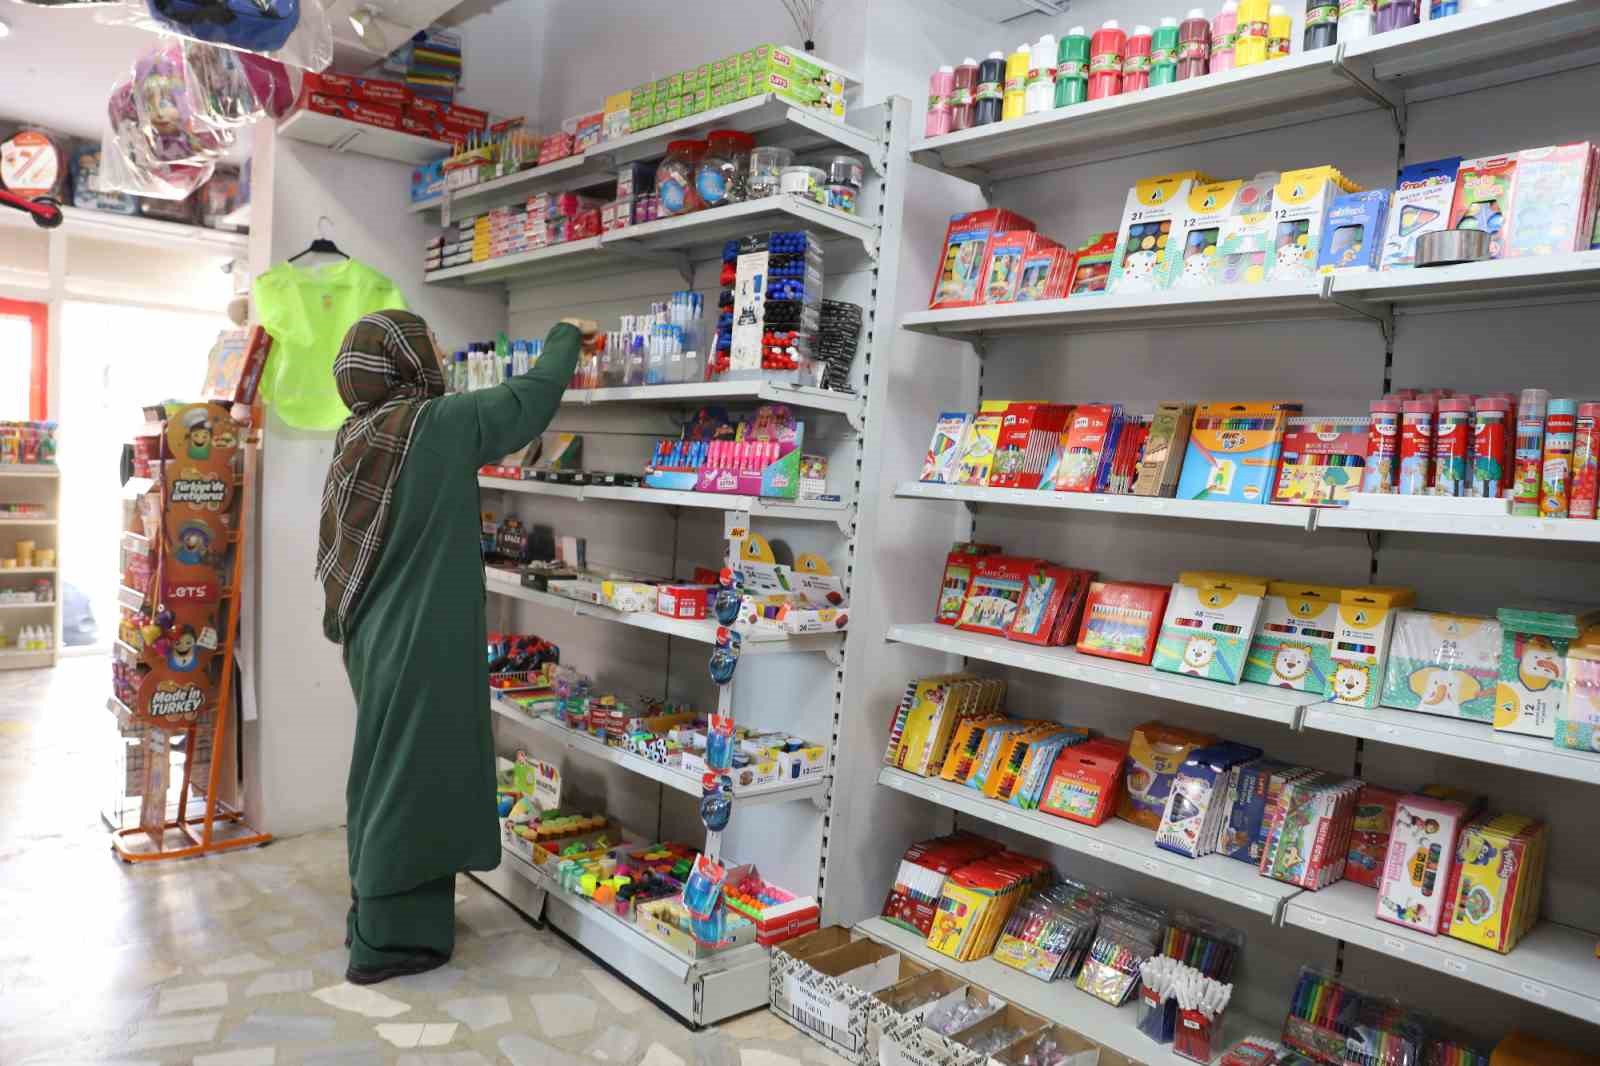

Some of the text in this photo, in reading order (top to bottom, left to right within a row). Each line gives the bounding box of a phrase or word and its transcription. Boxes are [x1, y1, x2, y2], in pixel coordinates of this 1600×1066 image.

[1275, 209, 1287, 218] 12
[1184, 219, 1196, 227] 12
[731, 528, 745, 537] BIC
[1443, 640, 1456, 649] 24
[154, 687, 201, 703] Made in
[152, 699, 201, 716] TURKEY
[1524, 704, 1534, 716] 12
[803, 767, 810, 775] 12
